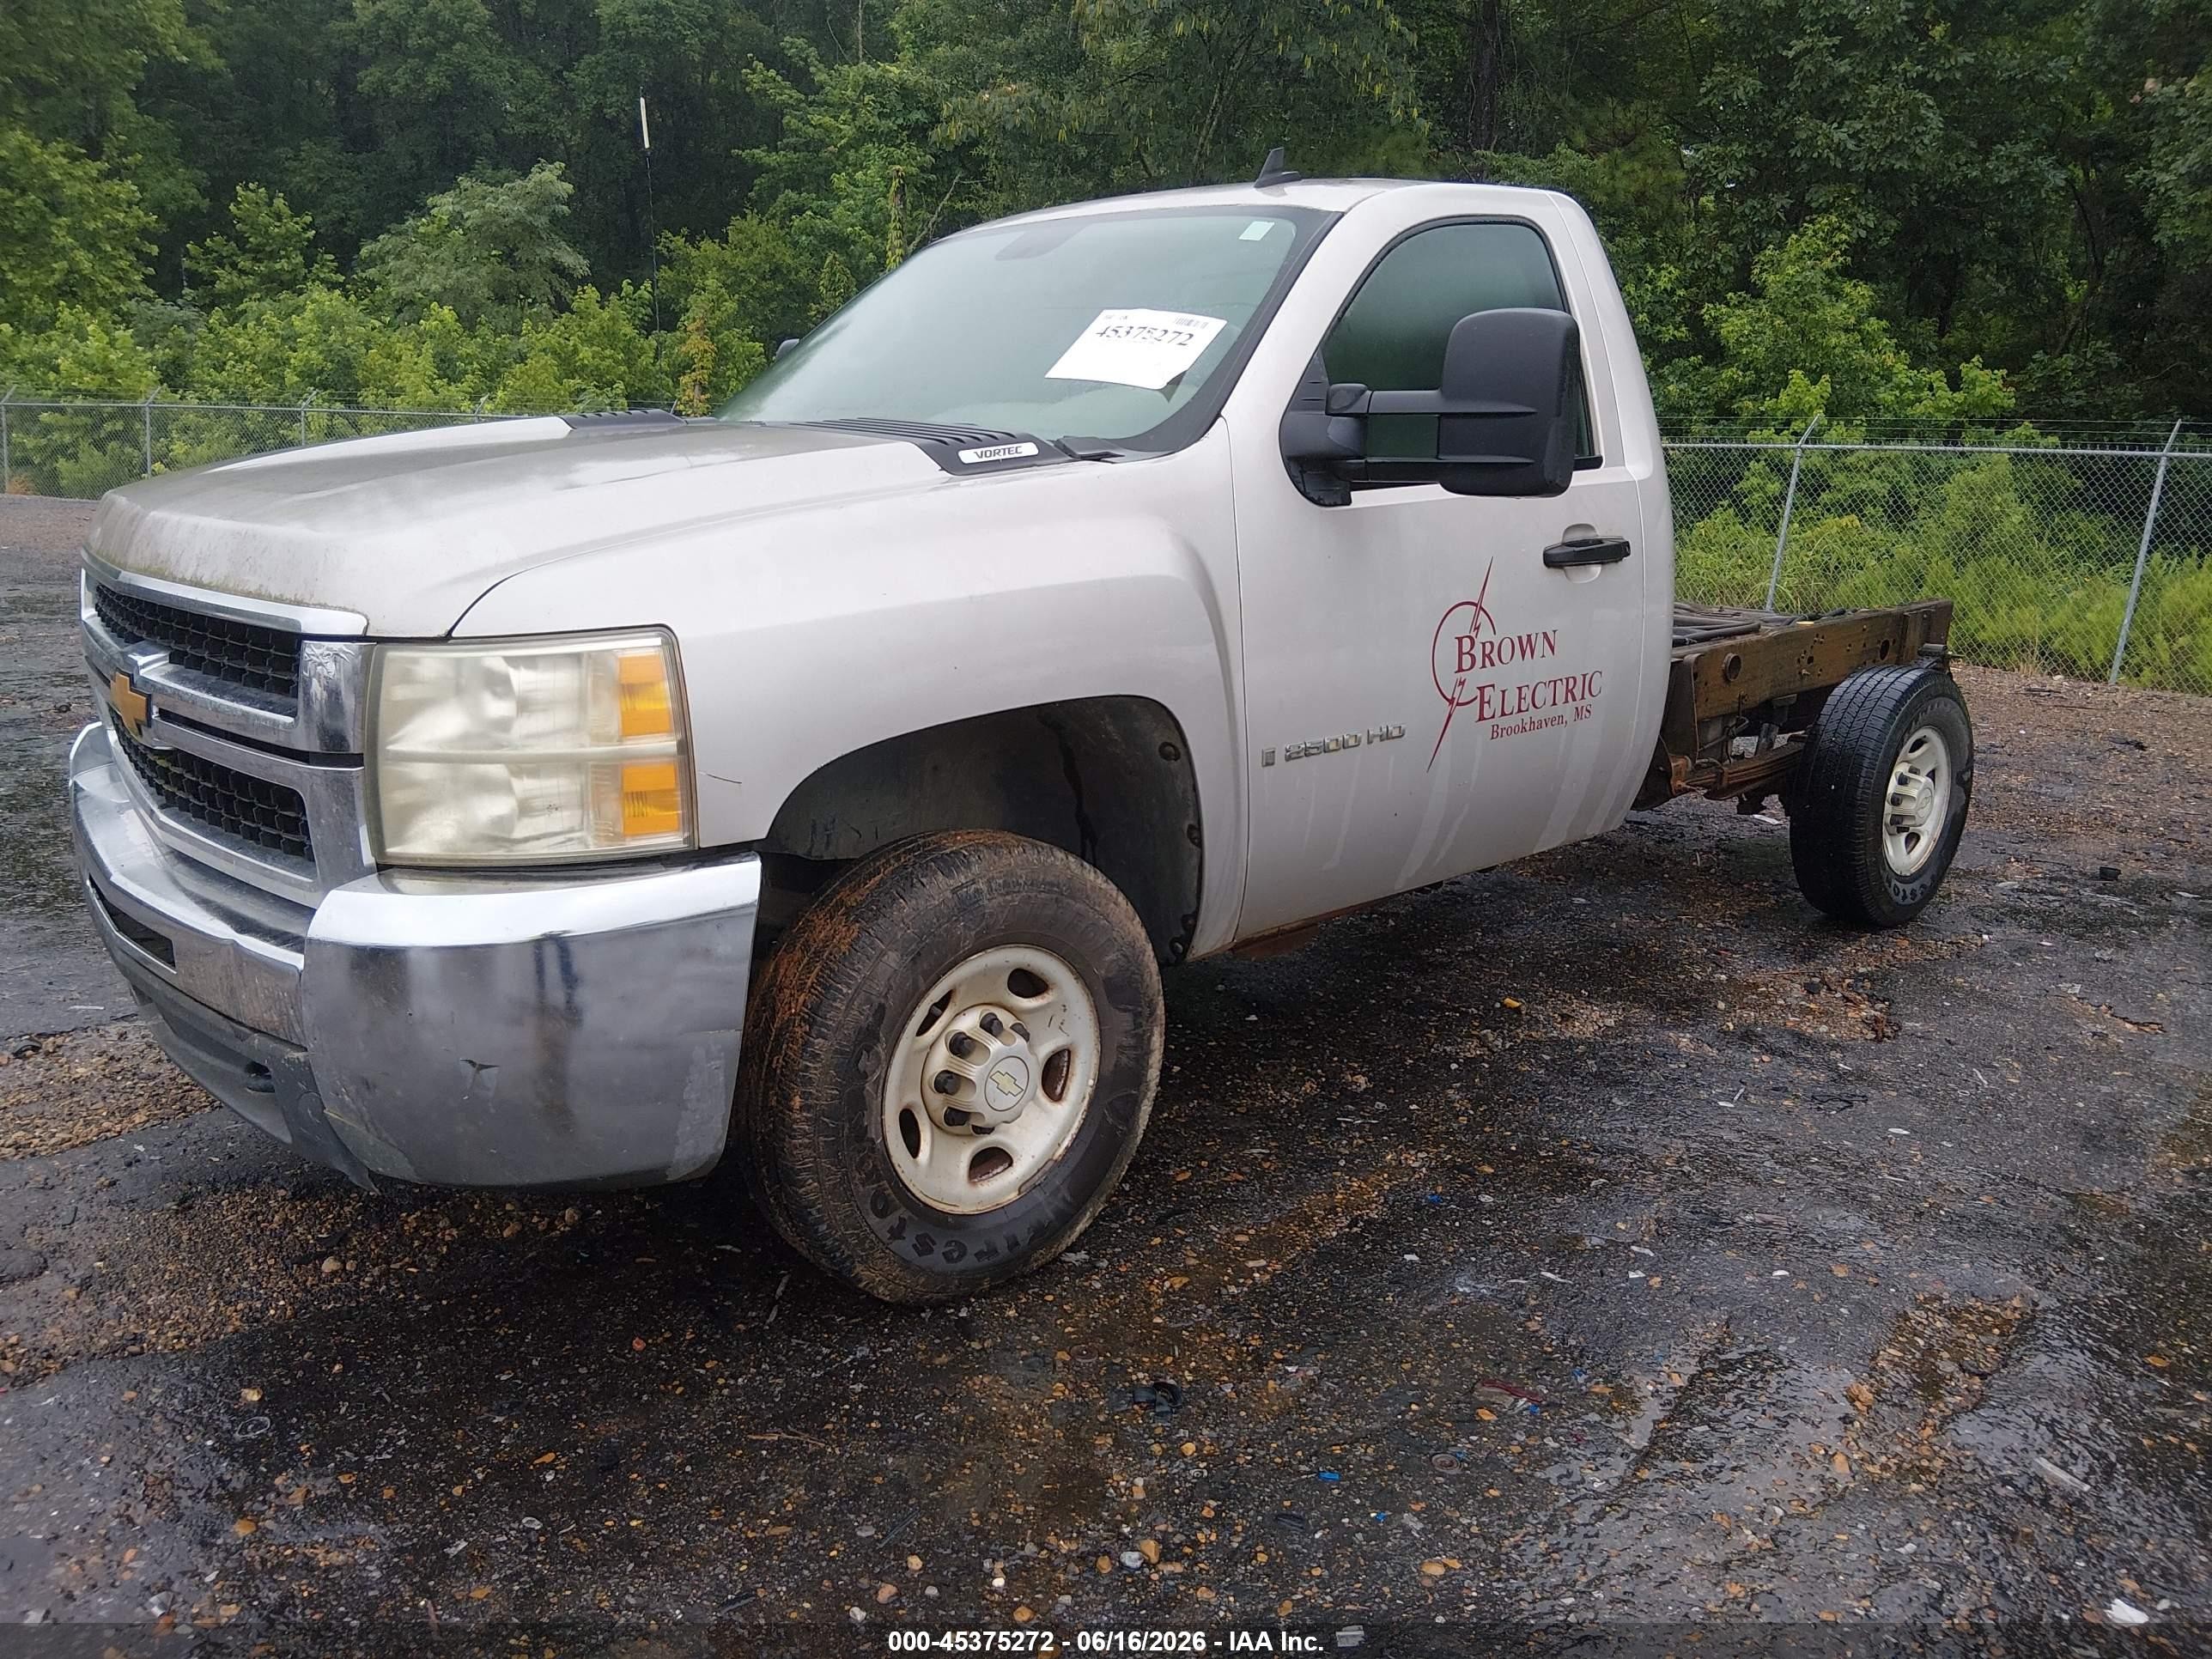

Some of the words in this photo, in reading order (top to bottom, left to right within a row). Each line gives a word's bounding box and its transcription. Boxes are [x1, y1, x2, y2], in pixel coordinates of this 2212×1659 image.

[1096, 325, 1194, 346] 45375272
[974, 446, 1023, 459] VORTEC
[1490, 713, 1568, 740] Brookhaven,
[1573, 704, 1592, 723] MS
[1285, 732, 1363, 762] 2500
[1367, 722, 1407, 744] HD
